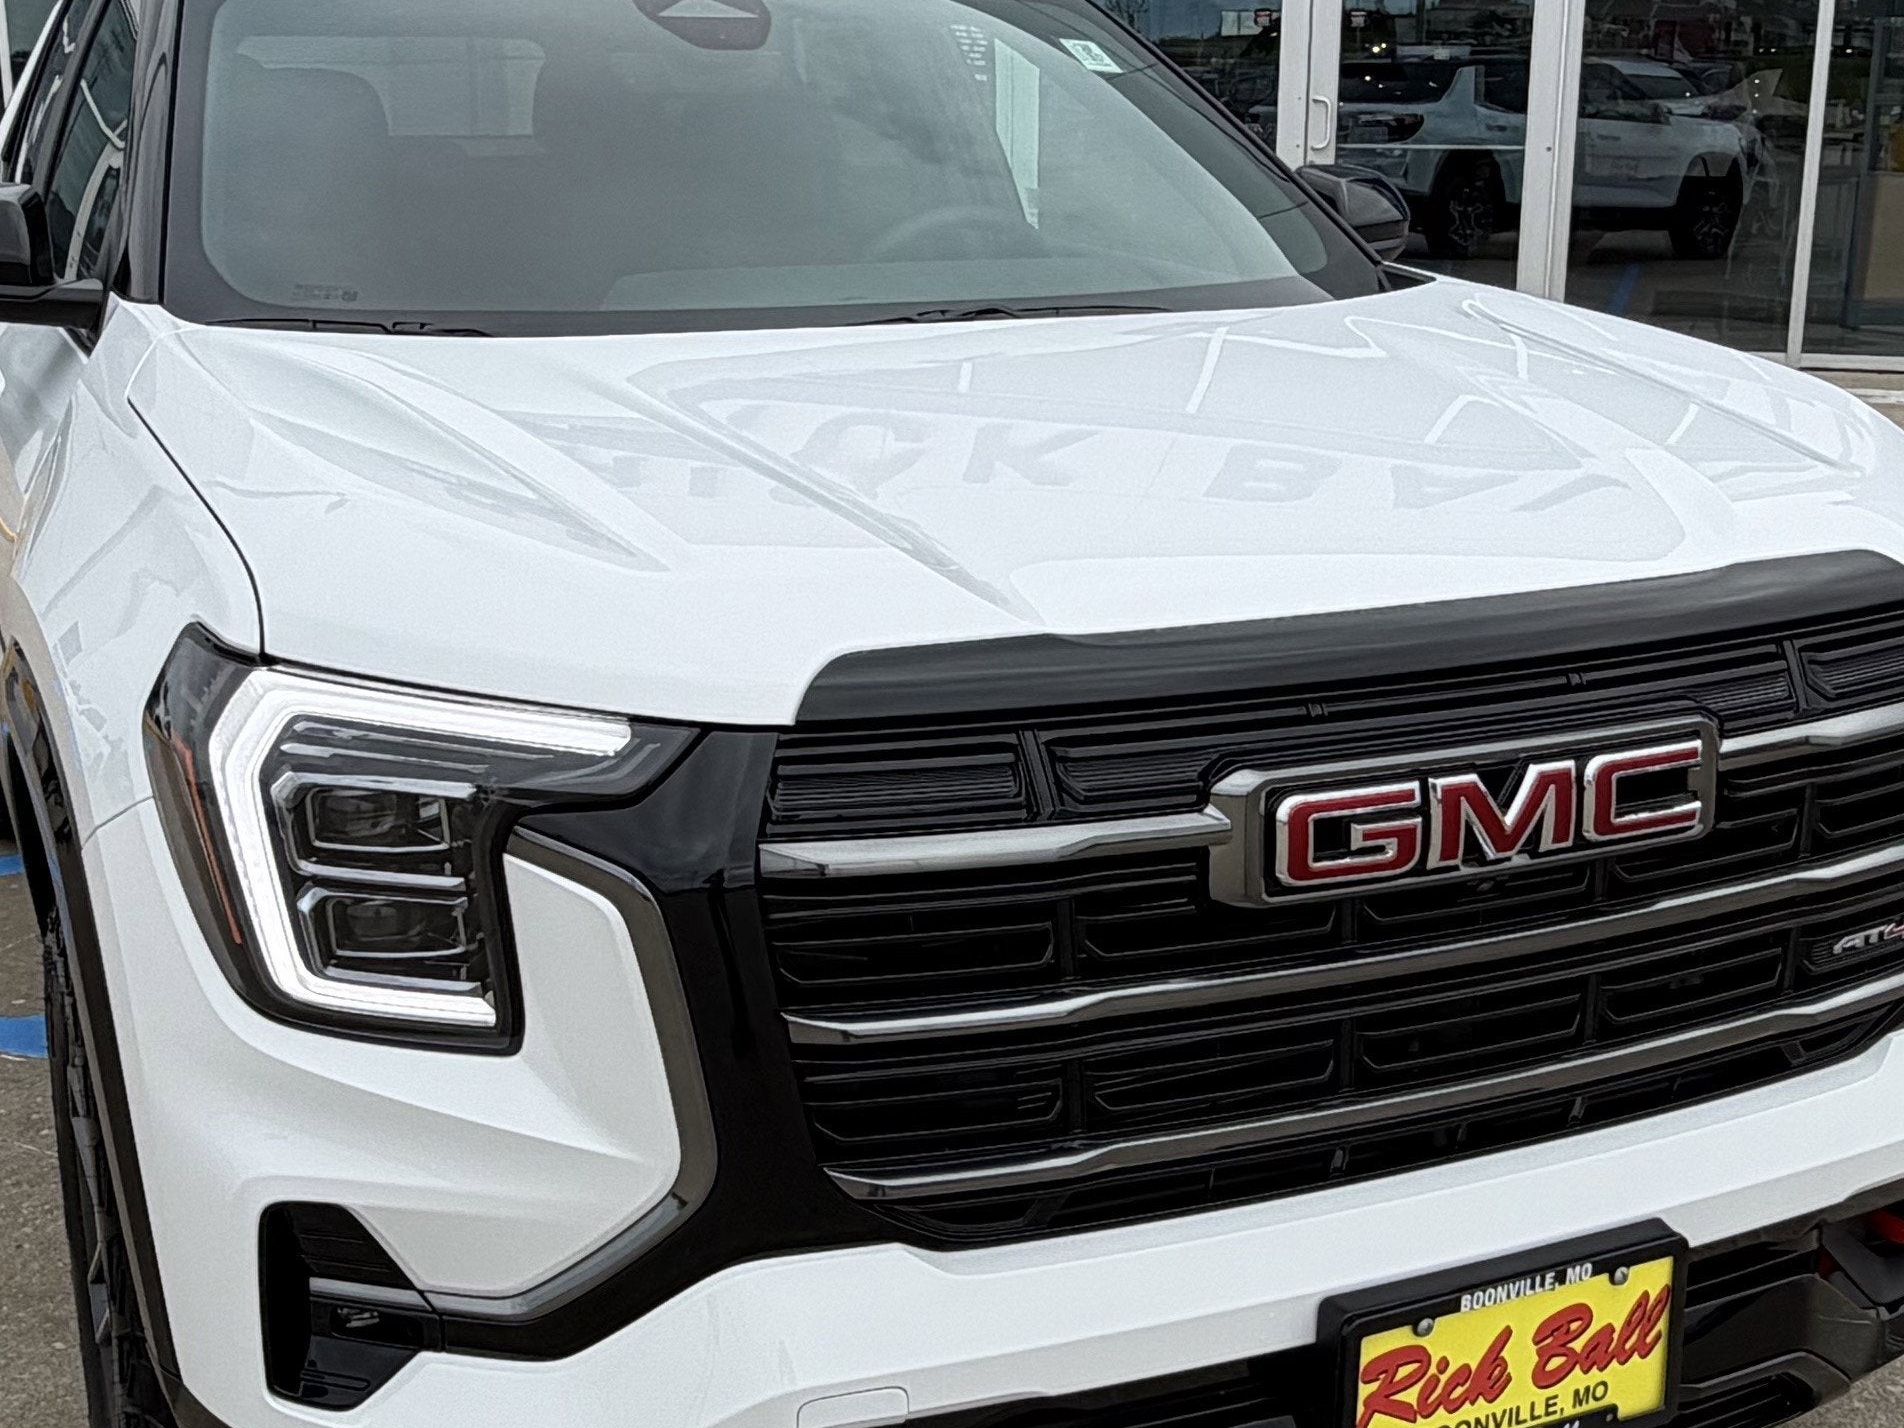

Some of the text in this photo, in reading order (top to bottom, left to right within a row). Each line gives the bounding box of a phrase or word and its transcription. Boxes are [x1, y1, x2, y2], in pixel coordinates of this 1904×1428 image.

[1276, 738, 1704, 887] GMC
[1565, 1262, 1593, 1285] MO
[1531, 1283, 1672, 1390] Ball
[1572, 1380, 1609, 1407] MO
